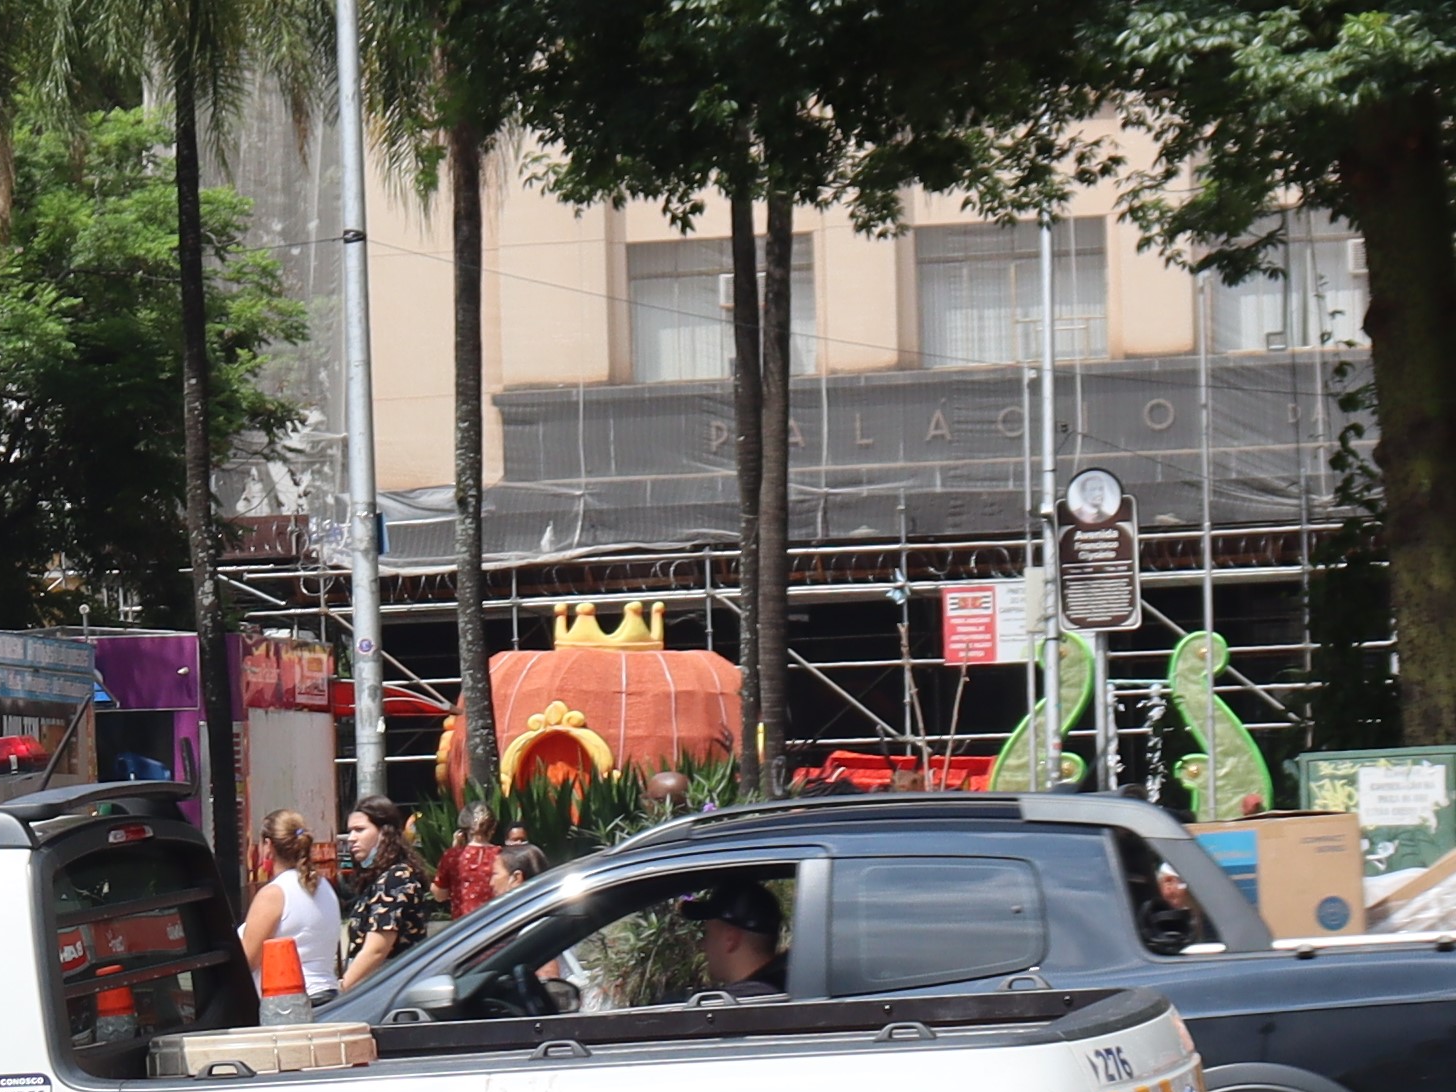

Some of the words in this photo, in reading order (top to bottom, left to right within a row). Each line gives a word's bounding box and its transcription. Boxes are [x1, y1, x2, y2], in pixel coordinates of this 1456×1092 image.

[1073, 528, 1120, 541] Avenida
[1094, 1046, 1134, 1082] 276
[0, 1076, 45, 1086] CONOSCO
